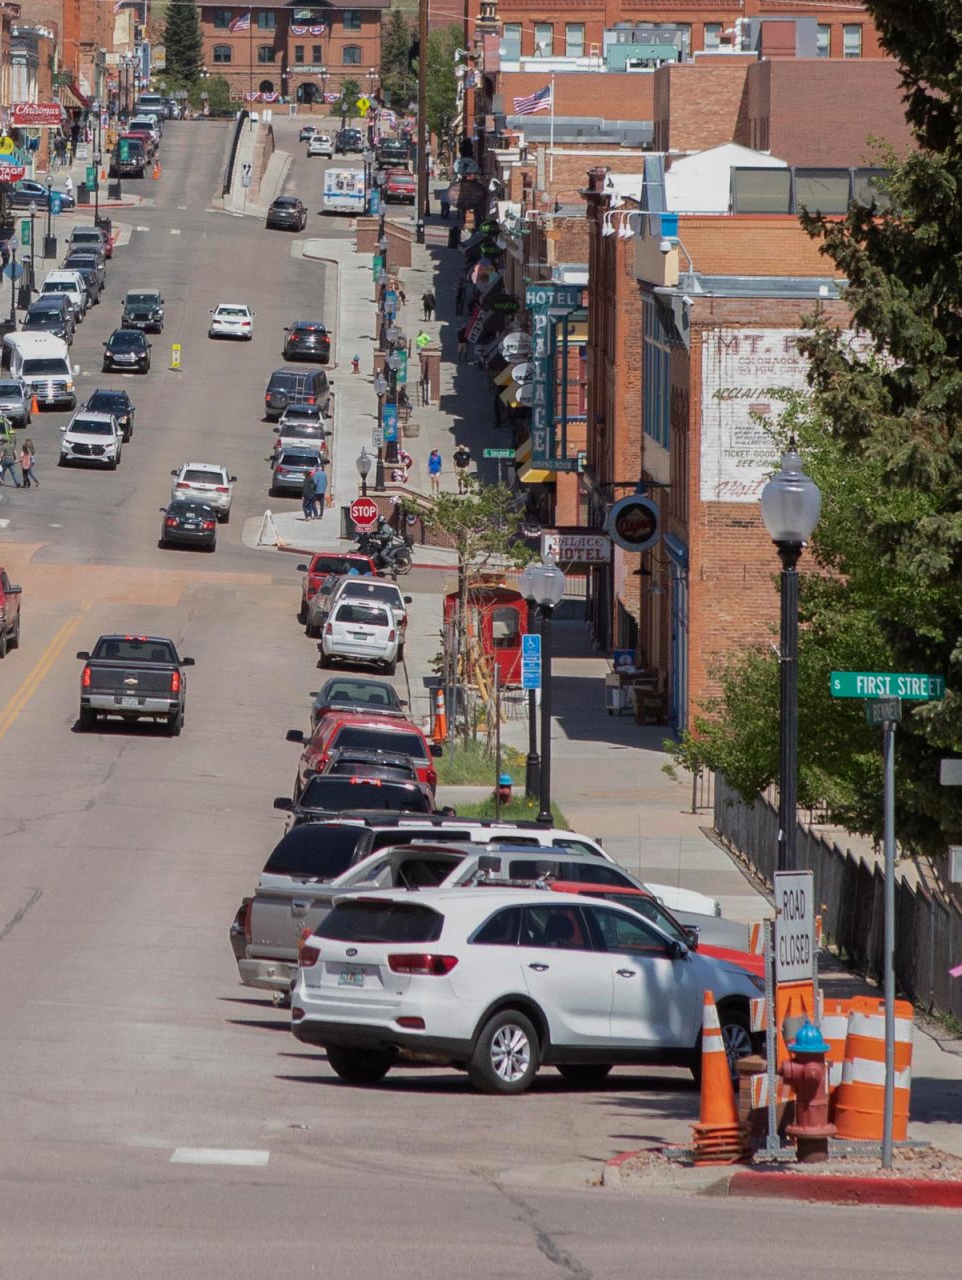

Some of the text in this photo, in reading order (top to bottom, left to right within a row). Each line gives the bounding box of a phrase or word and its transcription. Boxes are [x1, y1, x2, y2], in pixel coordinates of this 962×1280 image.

[526, 291, 574, 305] HOTEL
[534, 315, 546, 452] PALACE
[723, 450, 775, 458] TICKET GOOD
[736, 459, 754, 468] SEE
[352, 506, 376, 517] STOP
[553, 536, 604, 547] PALACE
[551, 548, 605, 560] HOTEL
[834, 676, 942, 696] S FIRST STREET
[783, 889, 806, 920] ROAD
[779, 933, 810, 967] CLOSED
